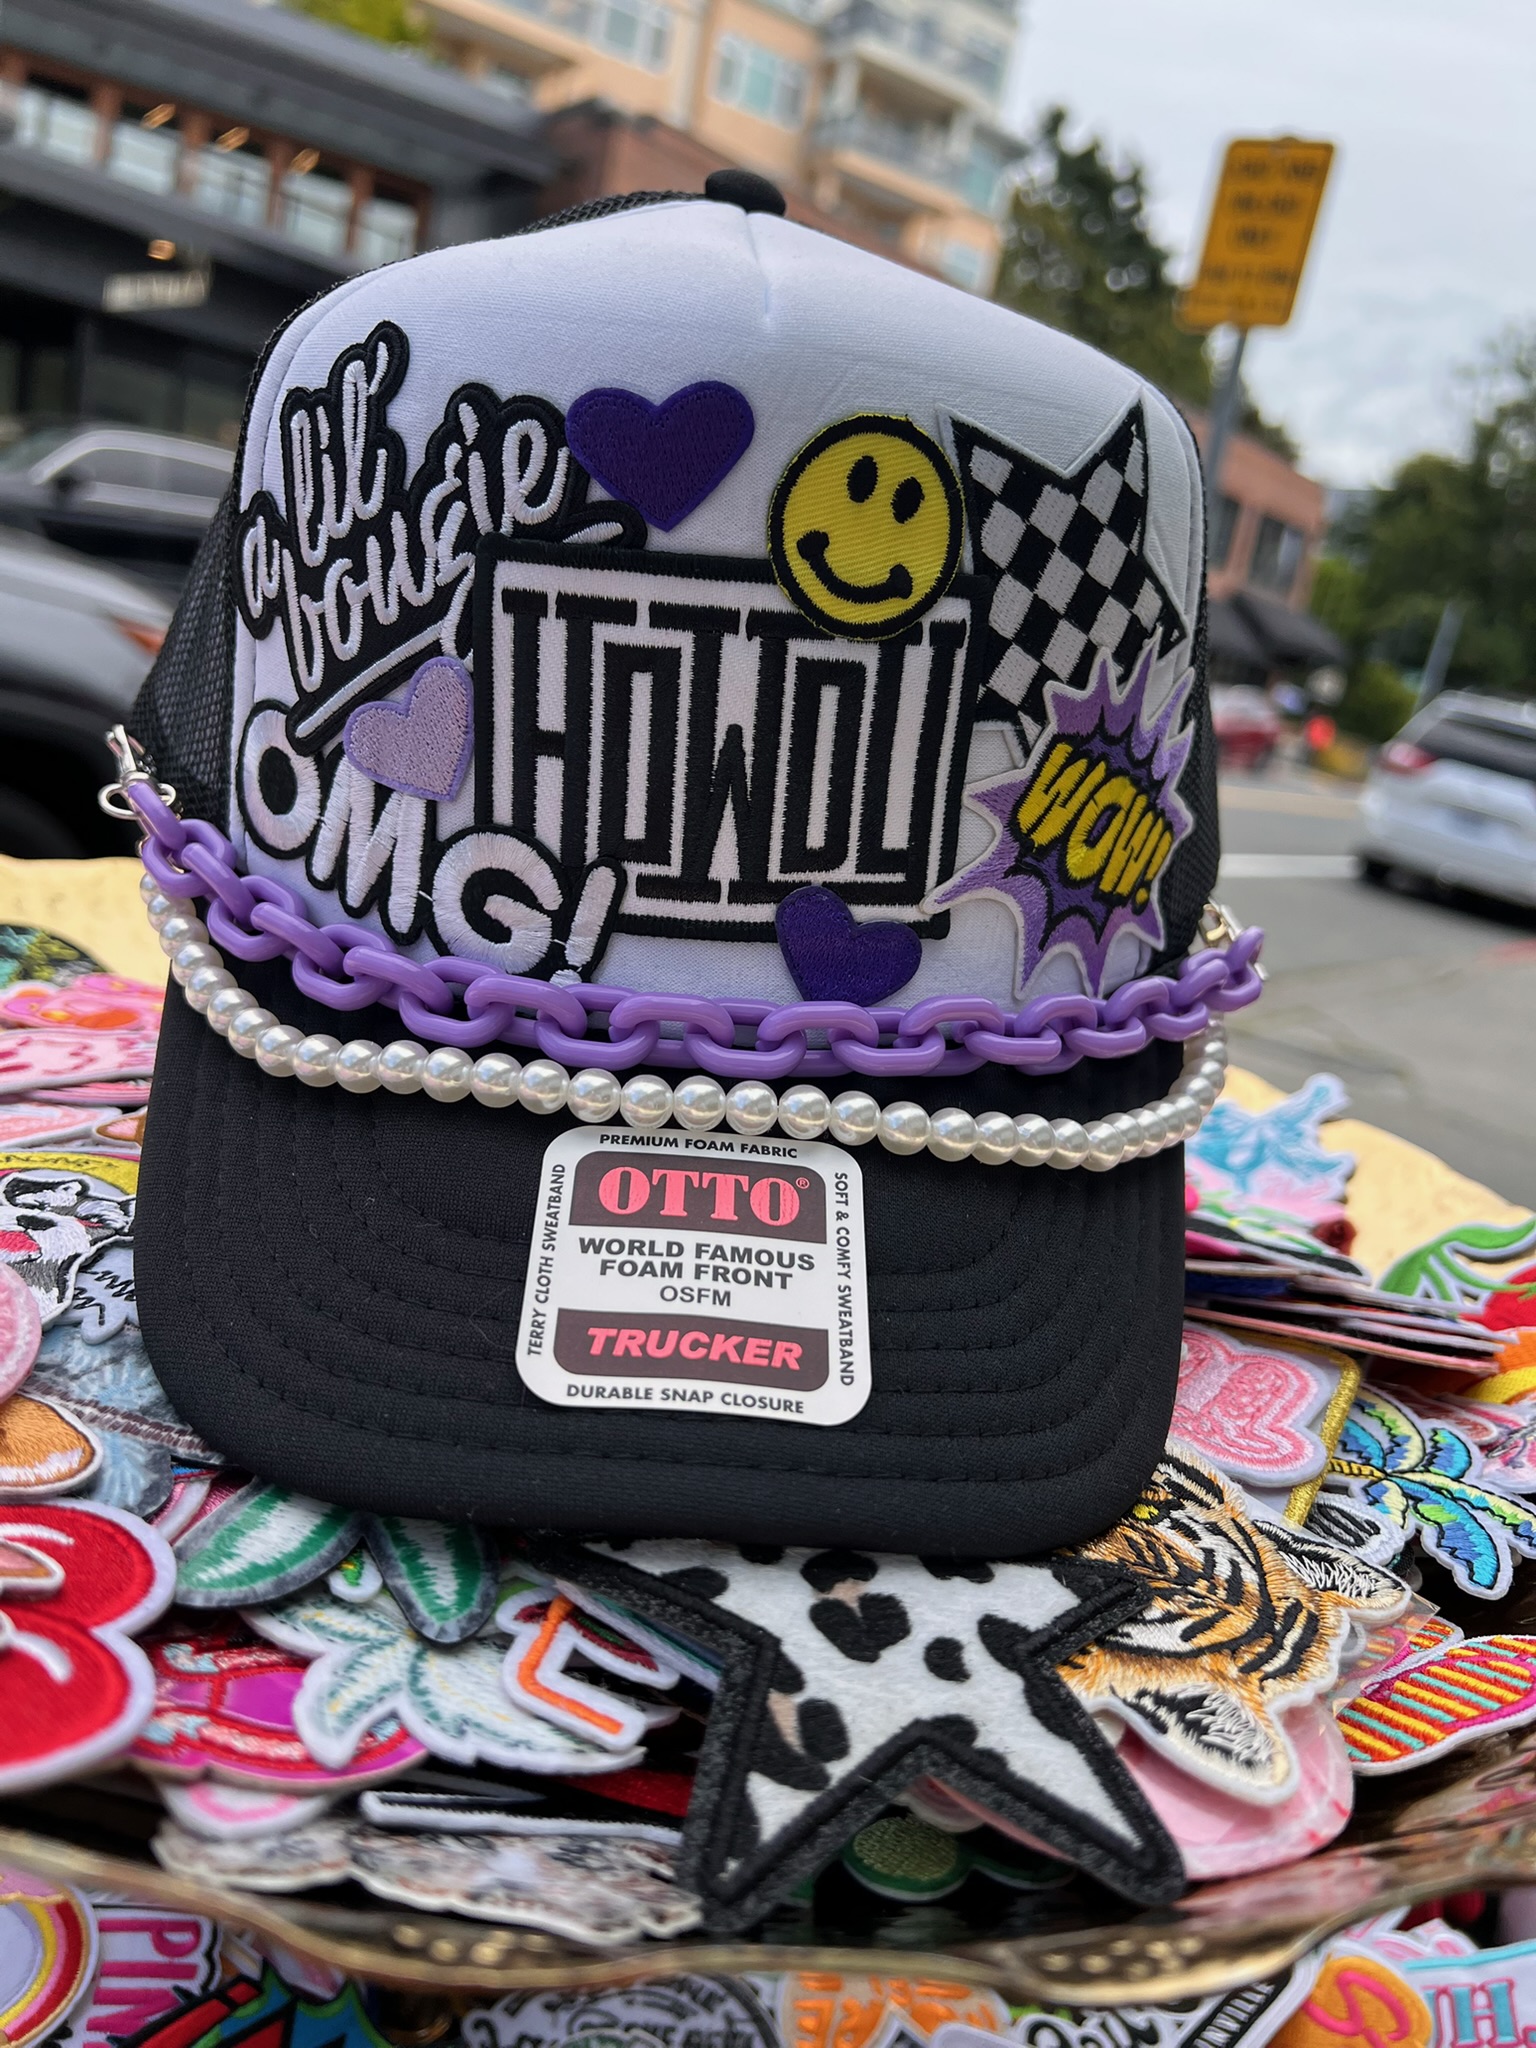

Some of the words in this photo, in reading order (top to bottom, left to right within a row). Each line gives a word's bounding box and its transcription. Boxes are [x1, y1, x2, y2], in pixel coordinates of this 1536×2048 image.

[501, 586, 969, 906] HOWDY
[238, 706, 620, 987] OMG!
[1015, 740, 1175, 906] WOW!
[599, 1133, 680, 1149] PREMIUM
[684, 1138, 736, 1153] FOAM
[740, 1142, 798, 1159] FABRIC
[541, 1163, 566, 1252] SWEATBAND
[834, 1171, 849, 1207] SOFT
[835, 1210, 850, 1222] &
[578, 1236, 685, 1258] WORLD
[695, 1242, 816, 1271] FAMOUS
[599, 1258, 684, 1280] FOAM
[693, 1263, 794, 1290] FRONT
[836, 1226, 852, 1280] COMFY
[534, 1255, 555, 1304] CLOTH
[659, 1285, 732, 1307] OSFM
[527, 1307, 548, 1357] TERRY
[586, 1326, 804, 1371] TRUCKER
[837, 1284, 855, 1387] SWEATBAND
[566, 1383, 654, 1401] DURABLE
[660, 1387, 714, 1404] SNAP
[720, 1391, 805, 1414] CLOSURE
[83, 1917, 201, 2048] PIN
